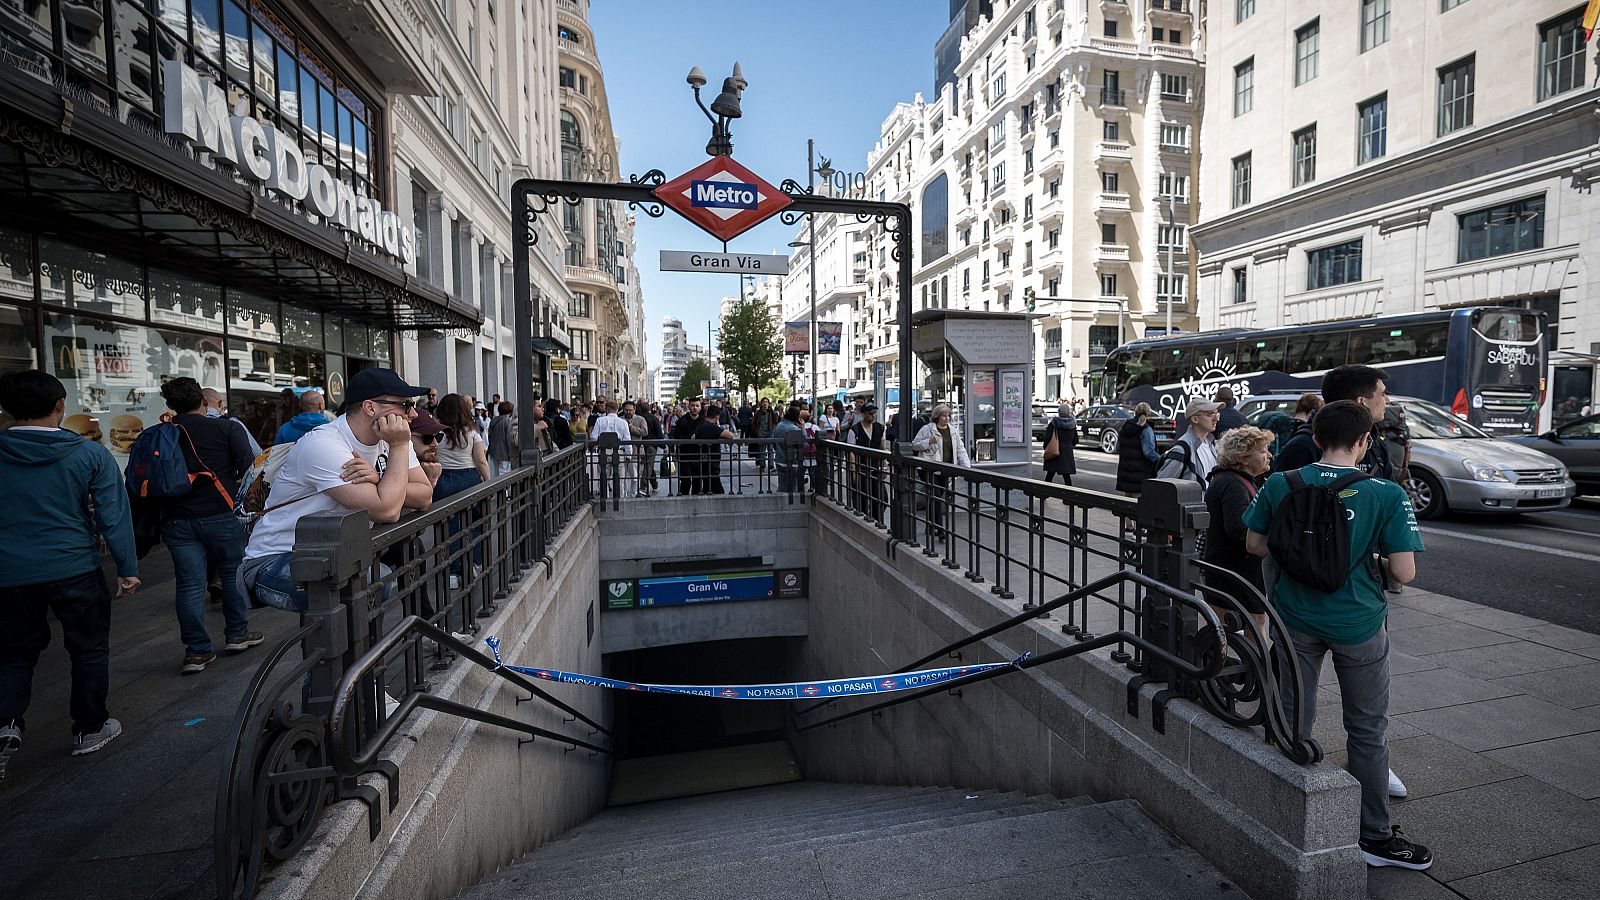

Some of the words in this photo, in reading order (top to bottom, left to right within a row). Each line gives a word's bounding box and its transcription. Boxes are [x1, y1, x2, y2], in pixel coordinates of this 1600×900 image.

[697, 184, 754, 204] Metro
[690, 254, 730, 268] Gran
[738, 255, 761, 269] Vía
[96, 358, 132, 373] 4YOU
[1180, 375, 1250, 399] Voyaes
[687, 583, 711, 593] Gran
[713, 581, 728, 591] Vía
[904, 676, 919, 686] NO
[920, 672, 948, 683] PASAR
[764, 688, 794, 697] PASAR
[827, 684, 842, 693] NO
[844, 682, 873, 692] PASAR
